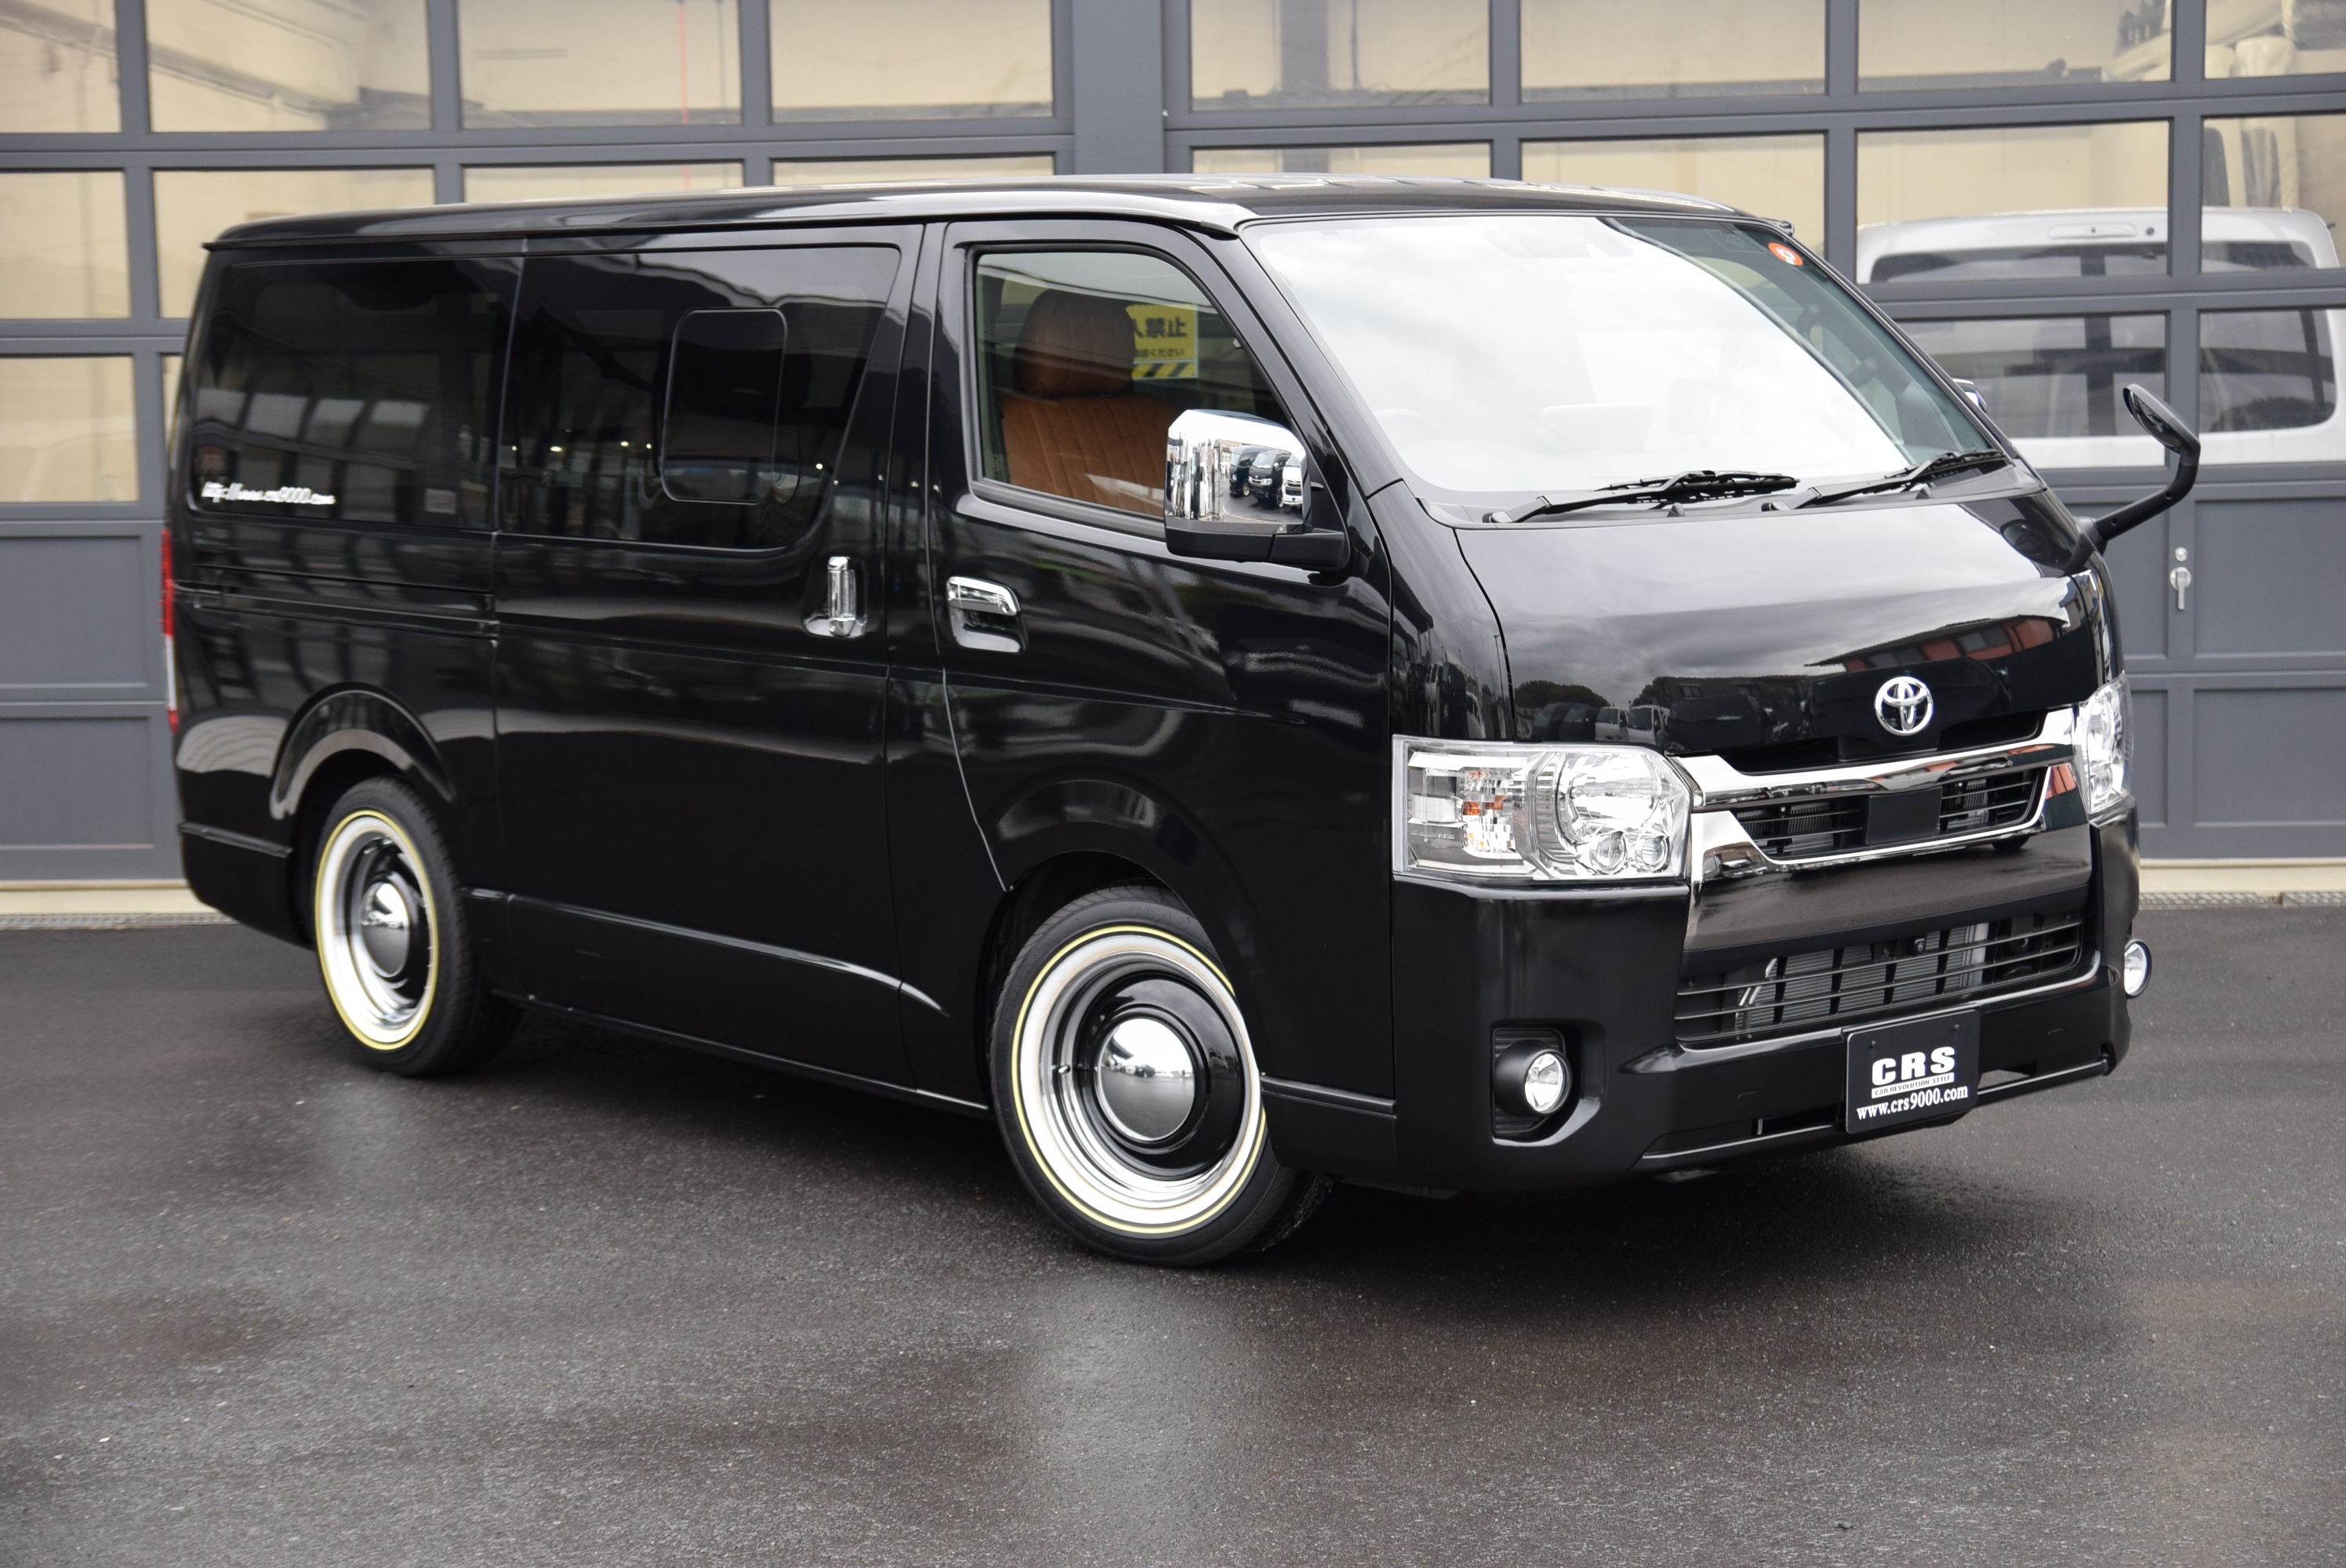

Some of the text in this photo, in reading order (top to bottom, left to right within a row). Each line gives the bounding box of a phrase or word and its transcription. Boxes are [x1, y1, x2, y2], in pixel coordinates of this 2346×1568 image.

[1872, 1047, 1956, 1086] CRS
[1856, 1085, 1969, 1120] www.crs9000.com
[1890, 1080, 1930, 1093] REVOLUTION
